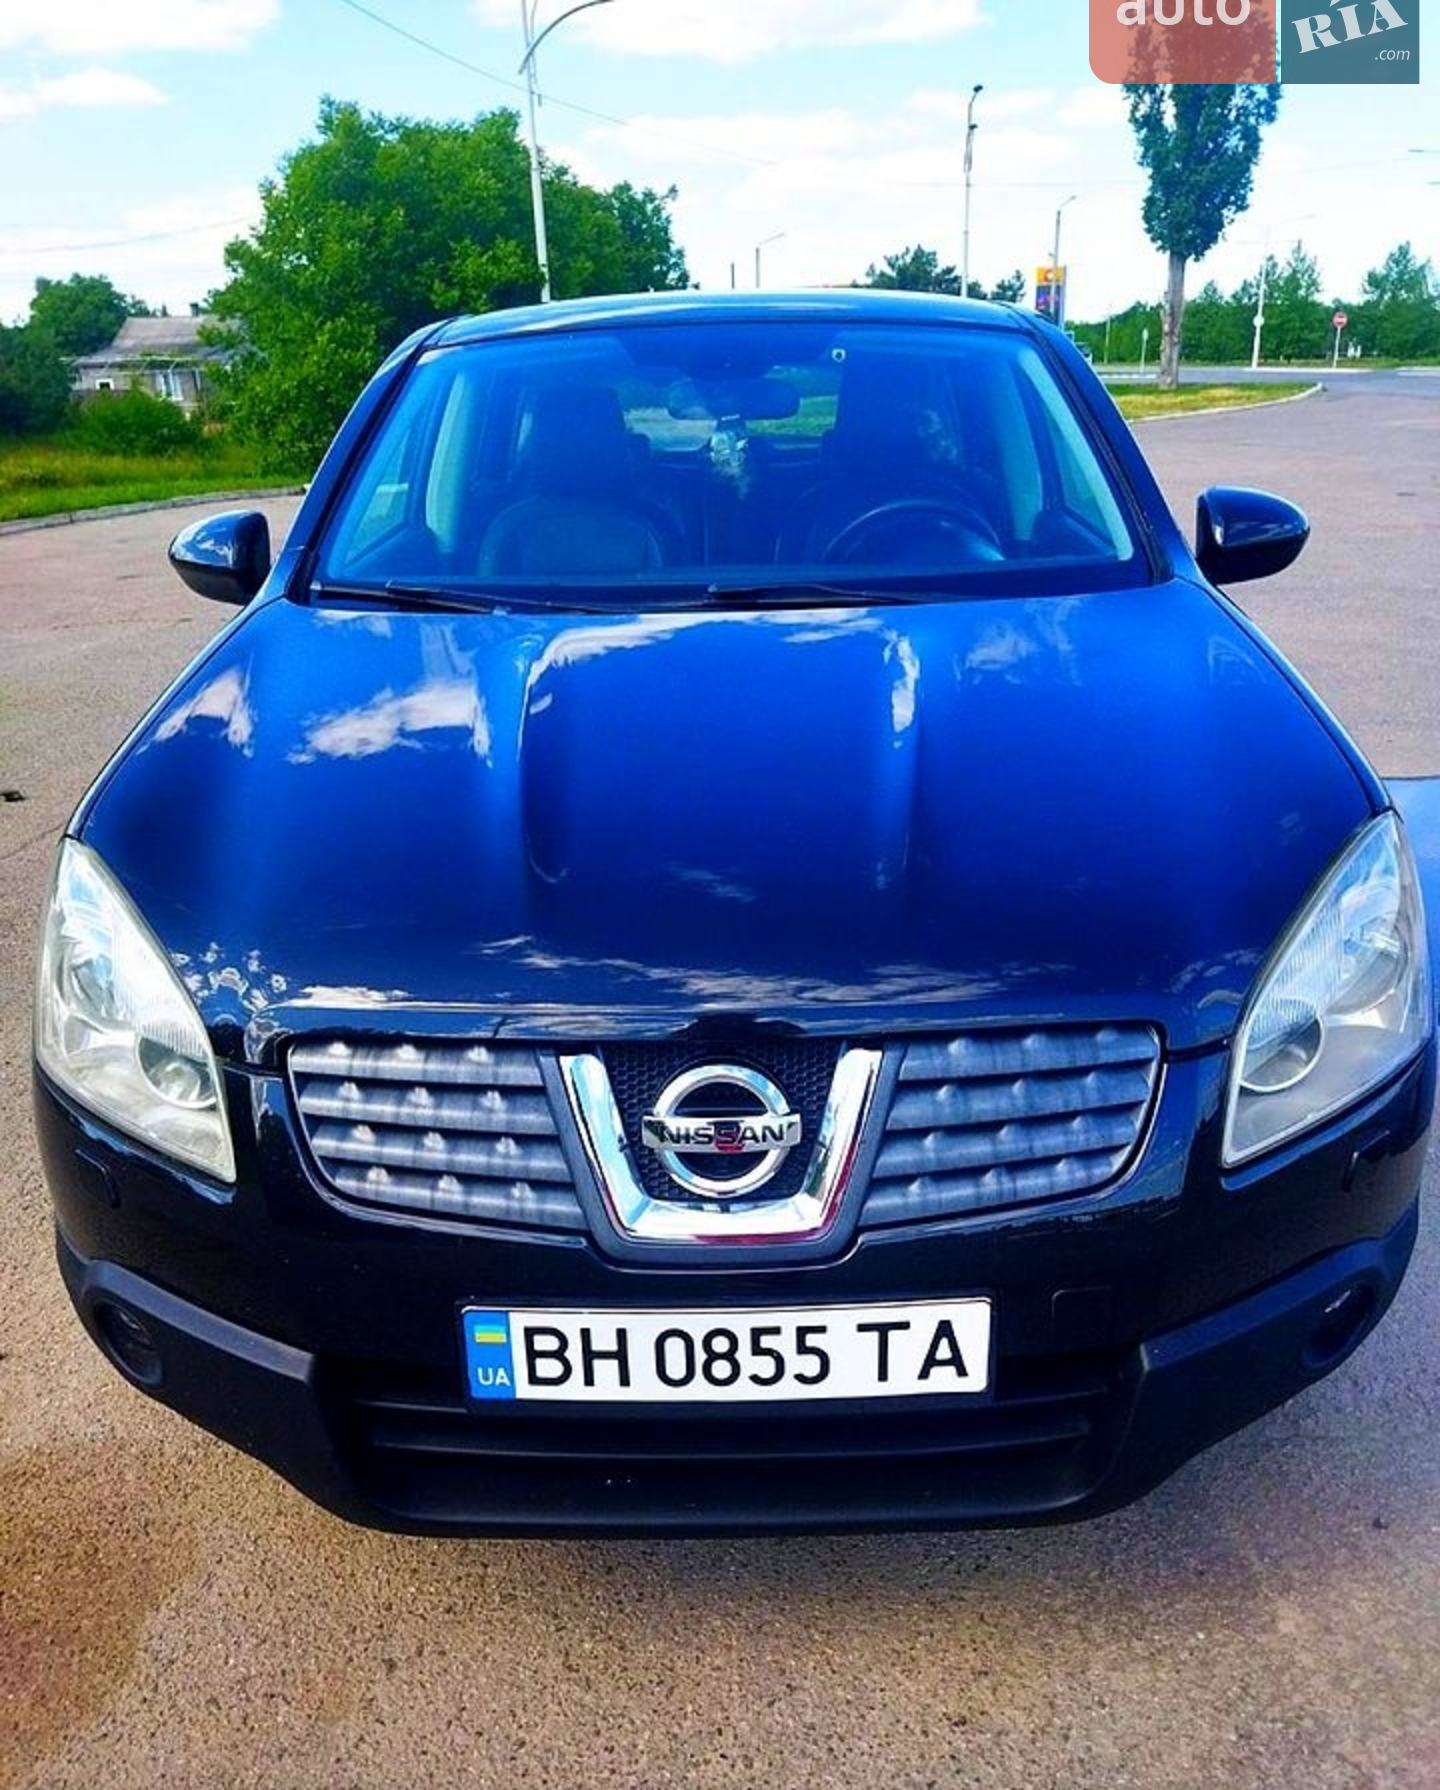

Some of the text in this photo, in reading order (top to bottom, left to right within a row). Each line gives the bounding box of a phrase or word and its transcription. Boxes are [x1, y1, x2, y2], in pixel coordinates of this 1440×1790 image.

[657, 1123, 785, 1145] NISSAN
[523, 1320, 969, 1388] BH 0855 TA
[477, 1367, 511, 1386] UA
